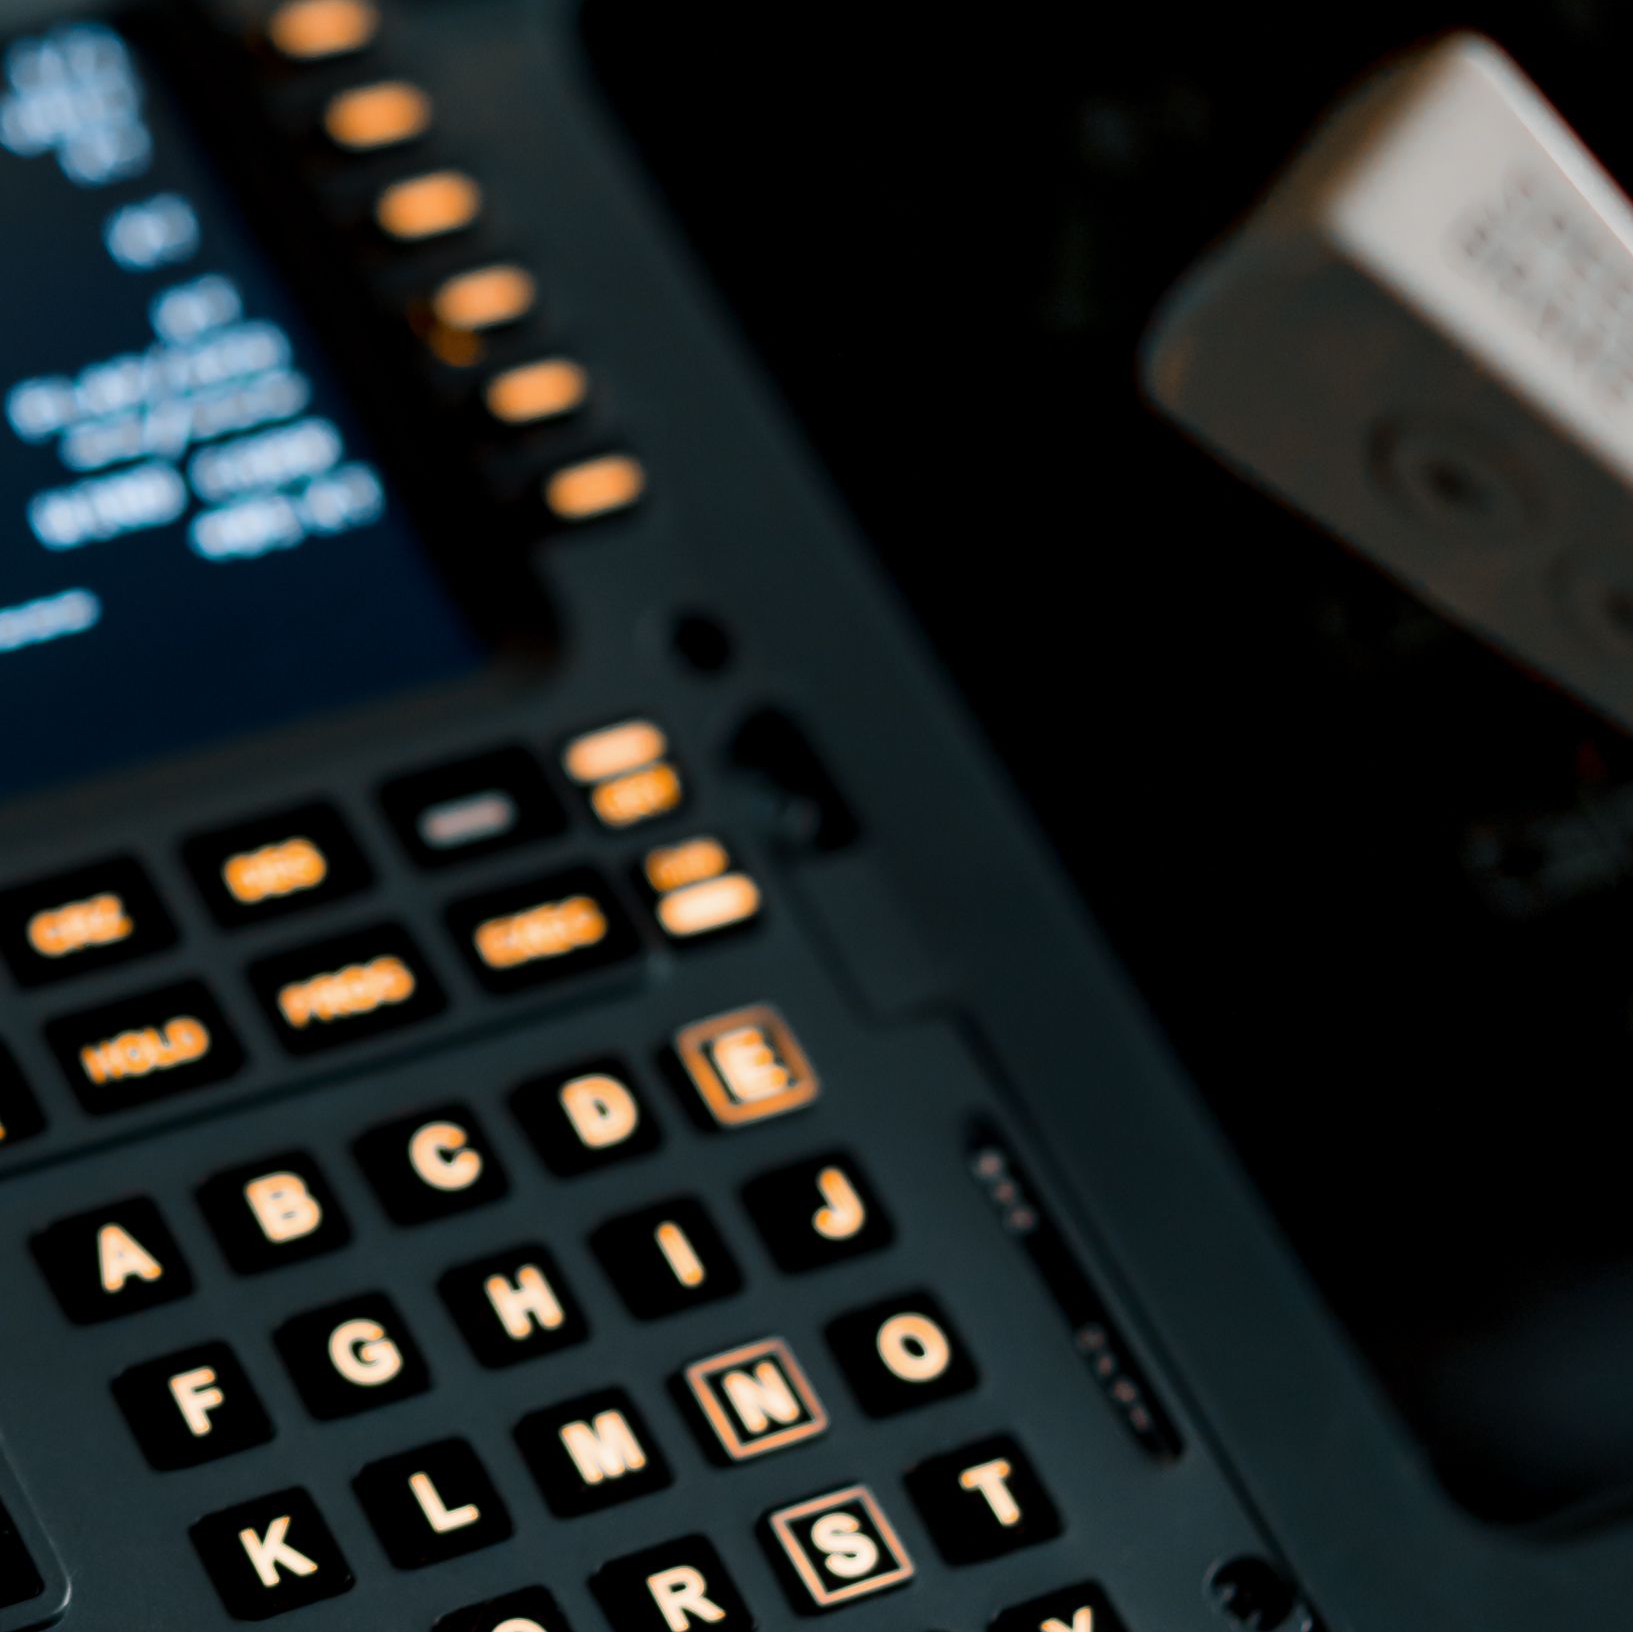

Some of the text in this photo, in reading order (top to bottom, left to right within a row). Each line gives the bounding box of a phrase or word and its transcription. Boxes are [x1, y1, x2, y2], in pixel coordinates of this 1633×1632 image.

[83, 1019, 208, 1082] HOLD
[715, 1028, 788, 1101] E
[562, 1076, 636, 1146] D
[411, 1124, 480, 1189] C
[247, 1174, 320, 1241] B
[815, 1169, 864, 1238] J
[99, 1226, 161, 1291] A
[487, 1267, 563, 1338] H
[329, 1320, 401, 1385] G
[878, 1315, 949, 1380] O
[170, 1368, 223, 1435] F
[722, 1364, 797, 1433] N
[561, 1411, 645, 1483] M
[410, 1474, 478, 1532] L
[961, 1460, 1020, 1525] T
[240, 1517, 317, 1586] K
[808, 1513, 879, 1578] S
[648, 1566, 725, 1632] R
